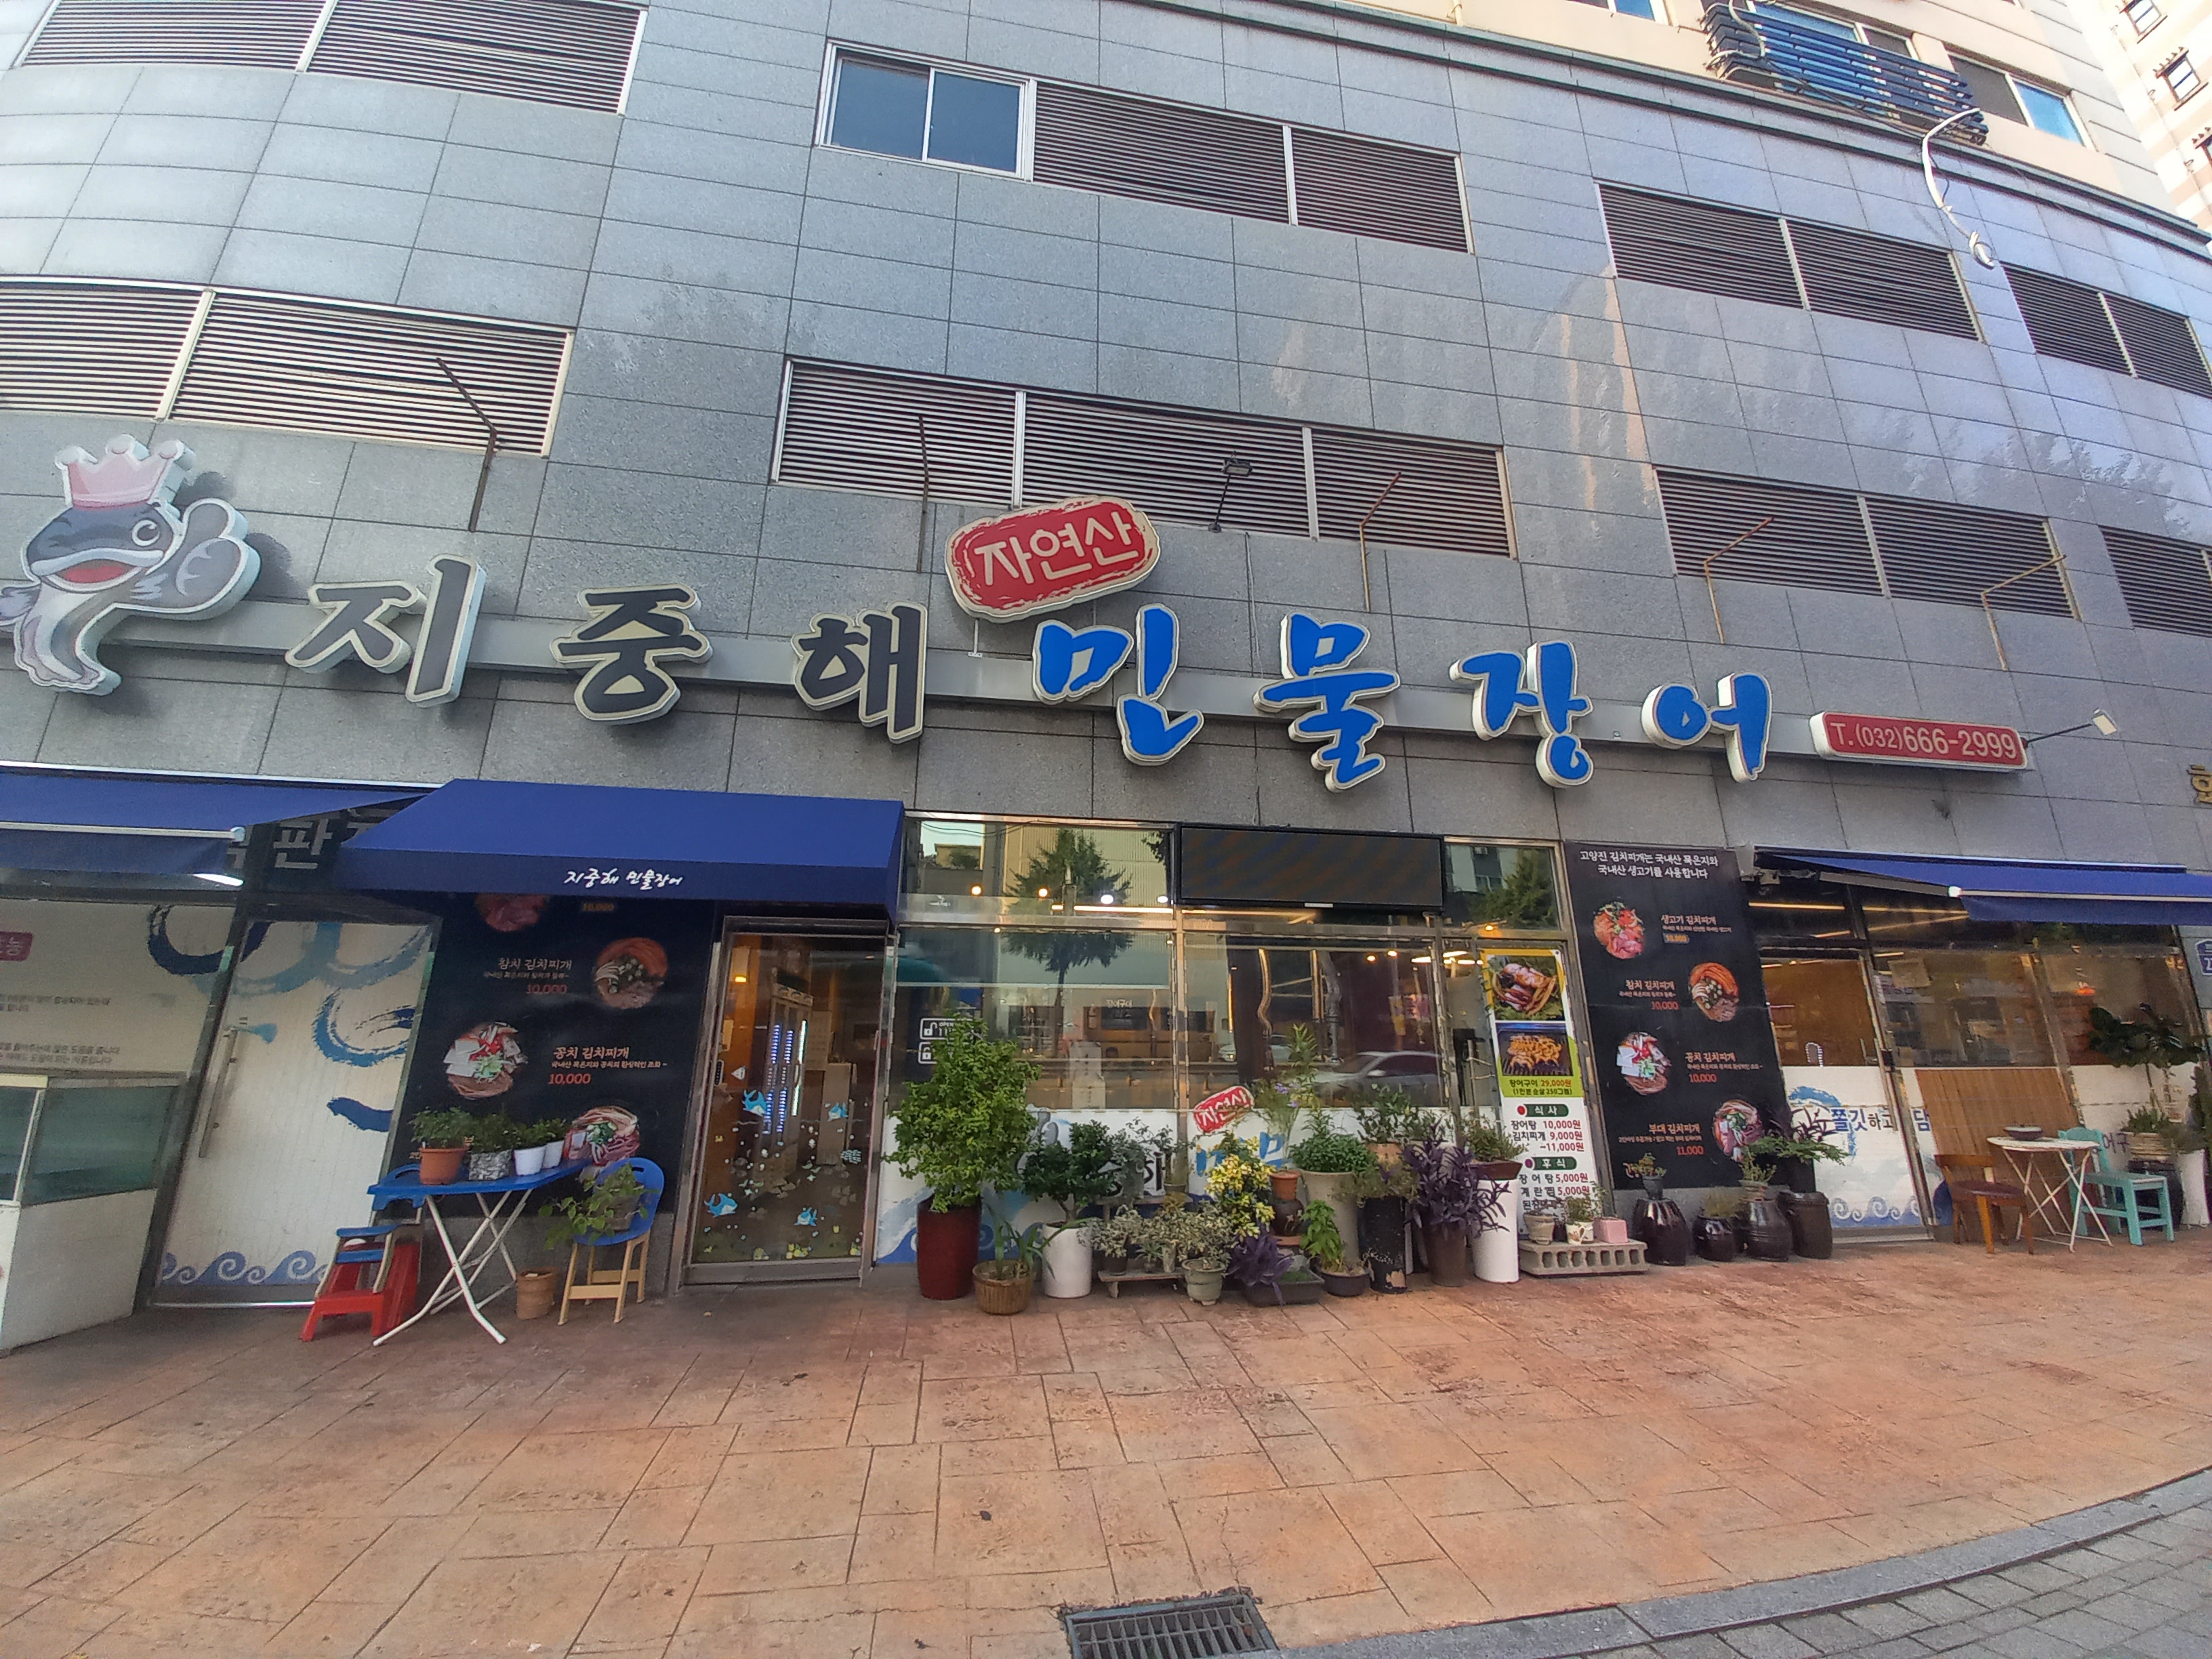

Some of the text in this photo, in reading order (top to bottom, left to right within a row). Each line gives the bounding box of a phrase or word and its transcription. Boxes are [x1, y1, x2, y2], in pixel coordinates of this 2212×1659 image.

[974, 510, 1139, 588] 자연산
[285, 554, 1771, 793] 지중해 민물장어
[1655, 854, 1681, 865] 국내산
[1597, 865, 1708, 879] 국내산 생고기를 사용합니다
[564, 867, 683, 890] 지중해 민물장어
[498, 958, 572, 970] 참치 김치찌개
[581, 1046, 630, 1059] 김치찌개
[1509, 1079, 1572, 1088] 장어구이 29,000원
[1511, 1120, 1581, 1130] 장어탕 10,000원
[1513, 1131, 1583, 1141] 김치찌개 9,000원
[1555, 1173, 1588, 1183] 5,000원
[1557, 1185, 1590, 1196] 5,000원
